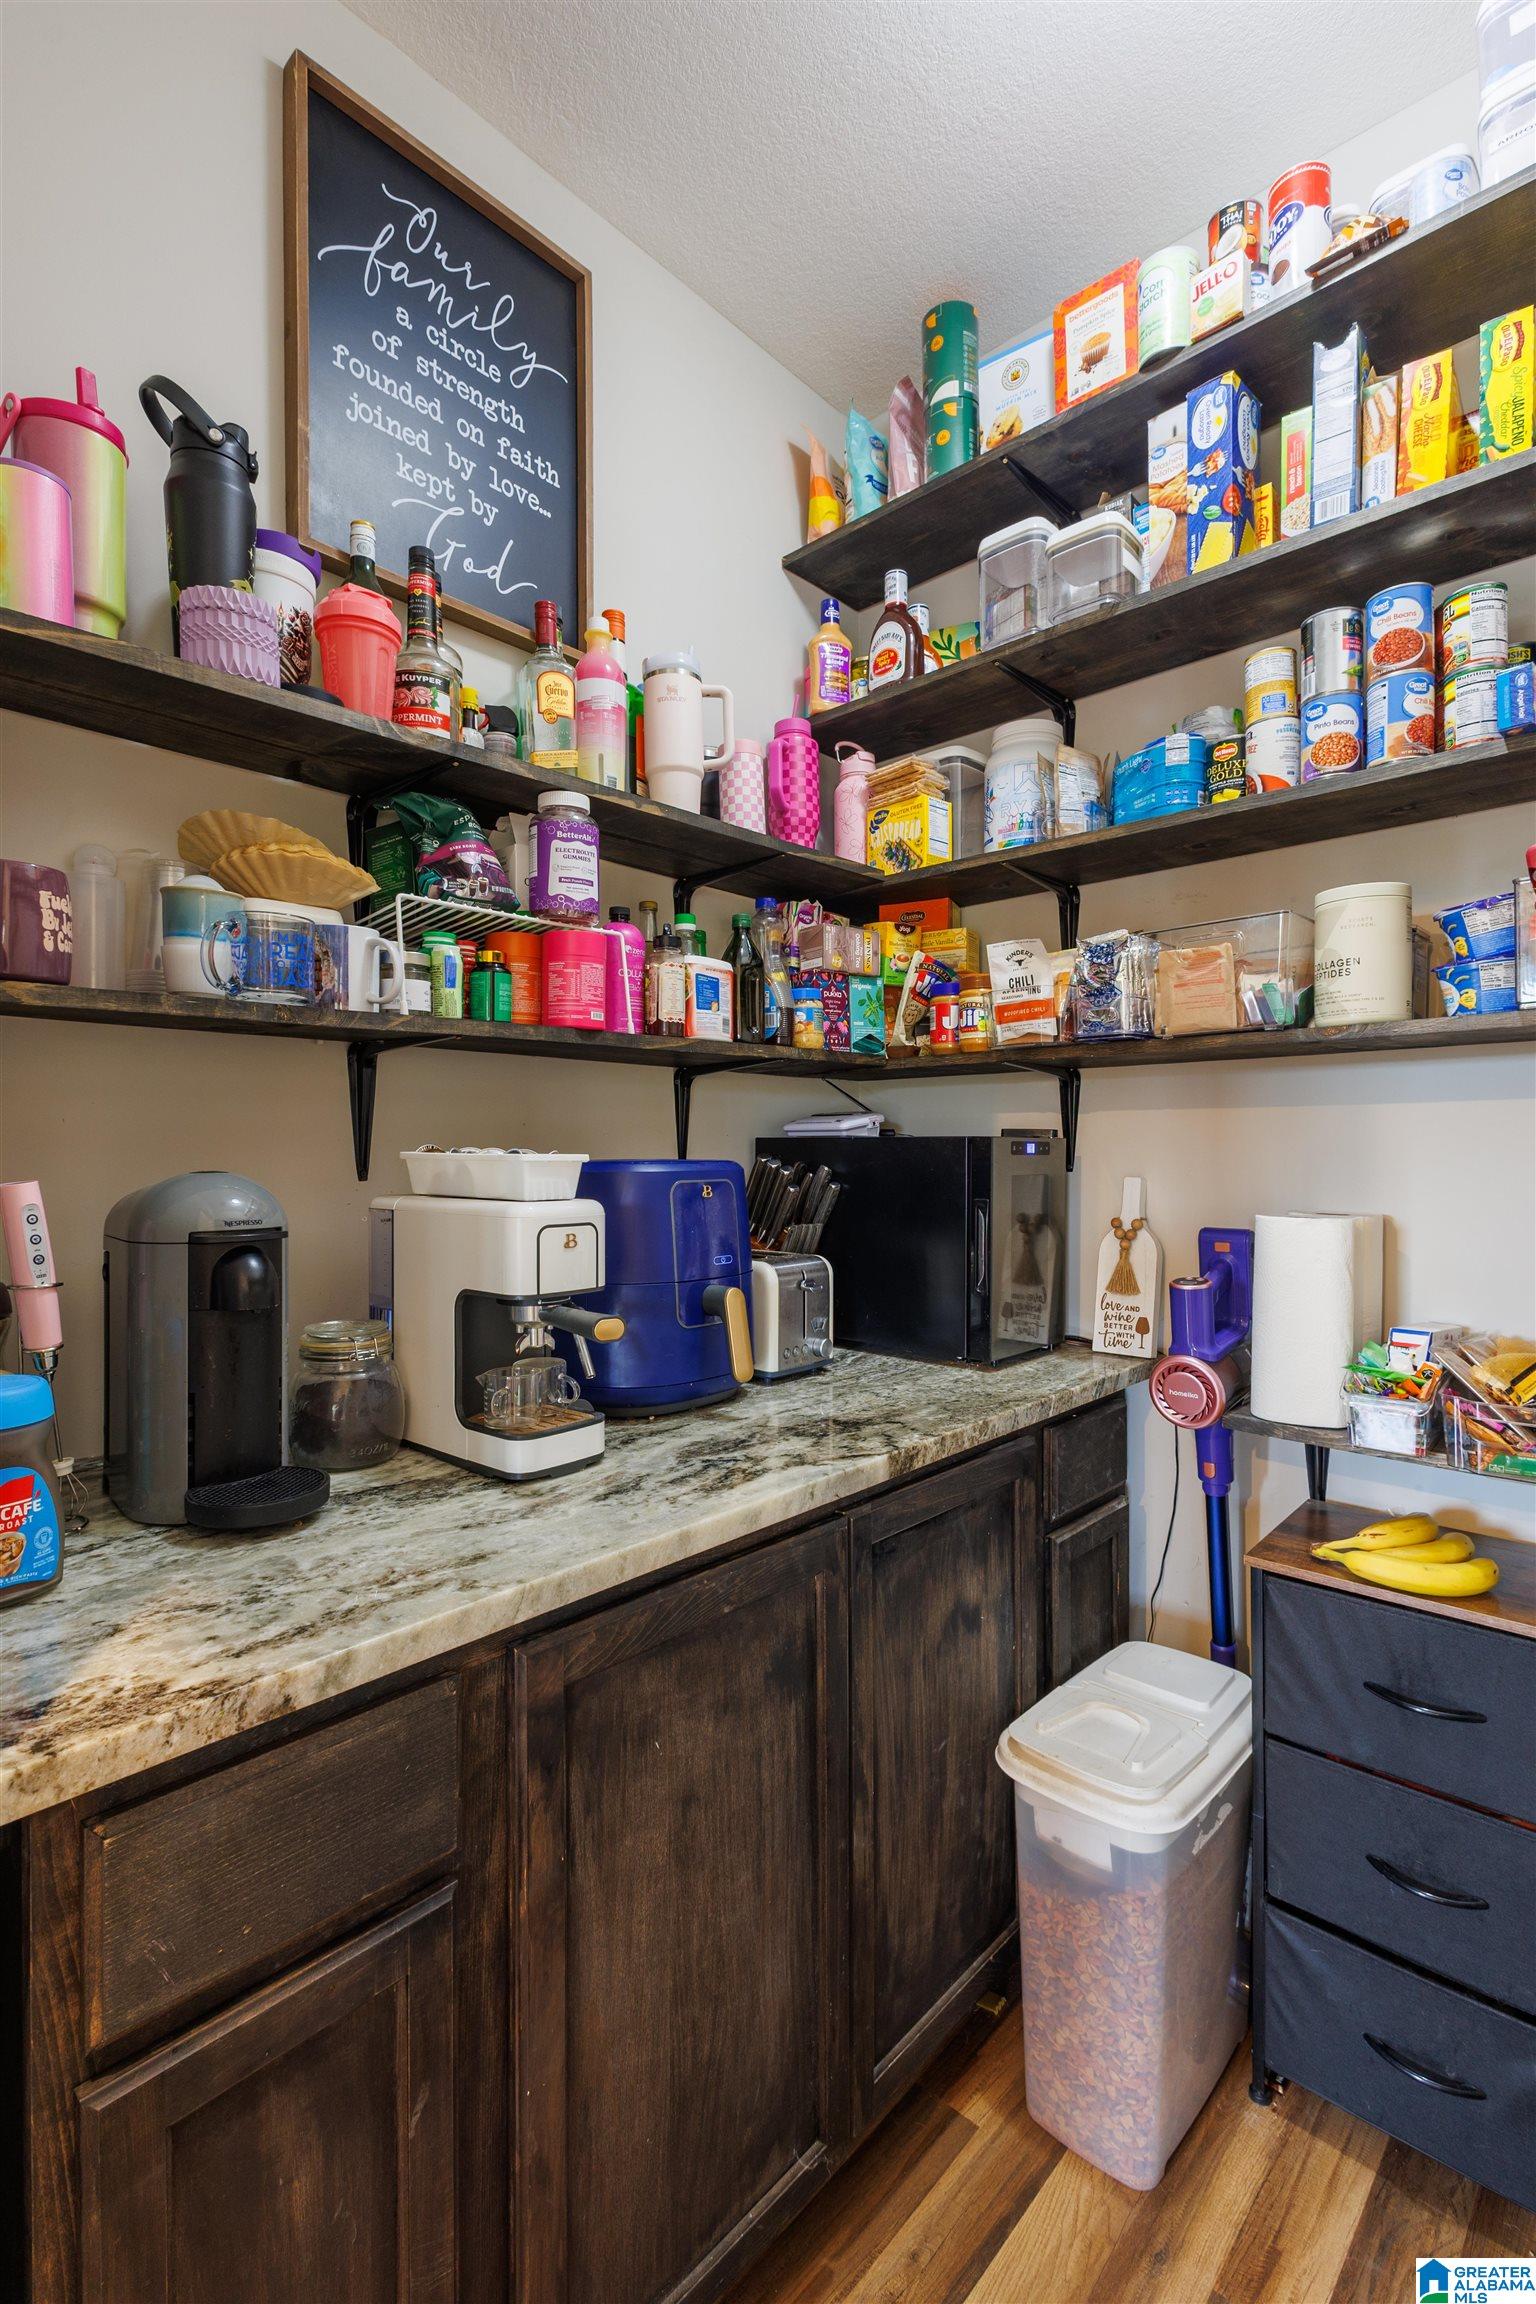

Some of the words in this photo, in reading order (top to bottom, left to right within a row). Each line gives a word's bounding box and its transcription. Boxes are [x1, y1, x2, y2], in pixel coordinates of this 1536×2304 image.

[381, 183, 490, 291] Our
[318, 223, 568, 388] family
[1069, 290, 1119, 323] bettergoods
[396, 305, 412, 330] a
[425, 324, 502, 383] circle
[371, 330, 403, 360] of
[416, 354, 526, 434] strength
[332, 344, 443, 425] founded
[456, 416, 485, 447] on
[496, 434, 561, 488] faith
[345, 393, 431, 456] joined
[445, 442, 476, 479] by
[1152, 453, 1184, 473] Mashed
[1150, 463, 1183, 480] Potatoes
[396, 453, 456, 502] kept
[468, 489, 499, 527] by
[392, 498, 538, 595] God
[1471, 605, 1494, 613] Calories
[1377, 615, 1392, 626] Chili
[1394, 610, 1417, 620] Beans
[401, 674, 443, 685] KUYPER
[1456, 671, 1491, 682] Nutrition
[545, 684, 568, 696] Cuervo
[1456, 687, 1479, 698] Calories
[1314, 721, 1331, 731] Pinto
[1333, 718, 1354, 726] Beans
[1210, 768, 1243, 783] GOLD
[890, 807, 910, 818] GLUTEN
[910, 803, 923, 811] FREE
[555, 847, 596, 858] ELECTROLYTE
[562, 853, 591, 863] GUMMIES
[922, 963, 949, 980] NATURAL
[1009, 974, 1035, 989] CHILI
[224, 1219, 263, 1227] NESPRESSO
[563, 1233, 577, 1249] B
[1100, 1293, 1125, 1311] love
[1104, 1311, 1136, 1323] wine
[1098, 1329, 1133, 1348] time
[1116, 1331, 1135, 1339] WITH
[0, 1490, 43, 1521] CAFÉ
